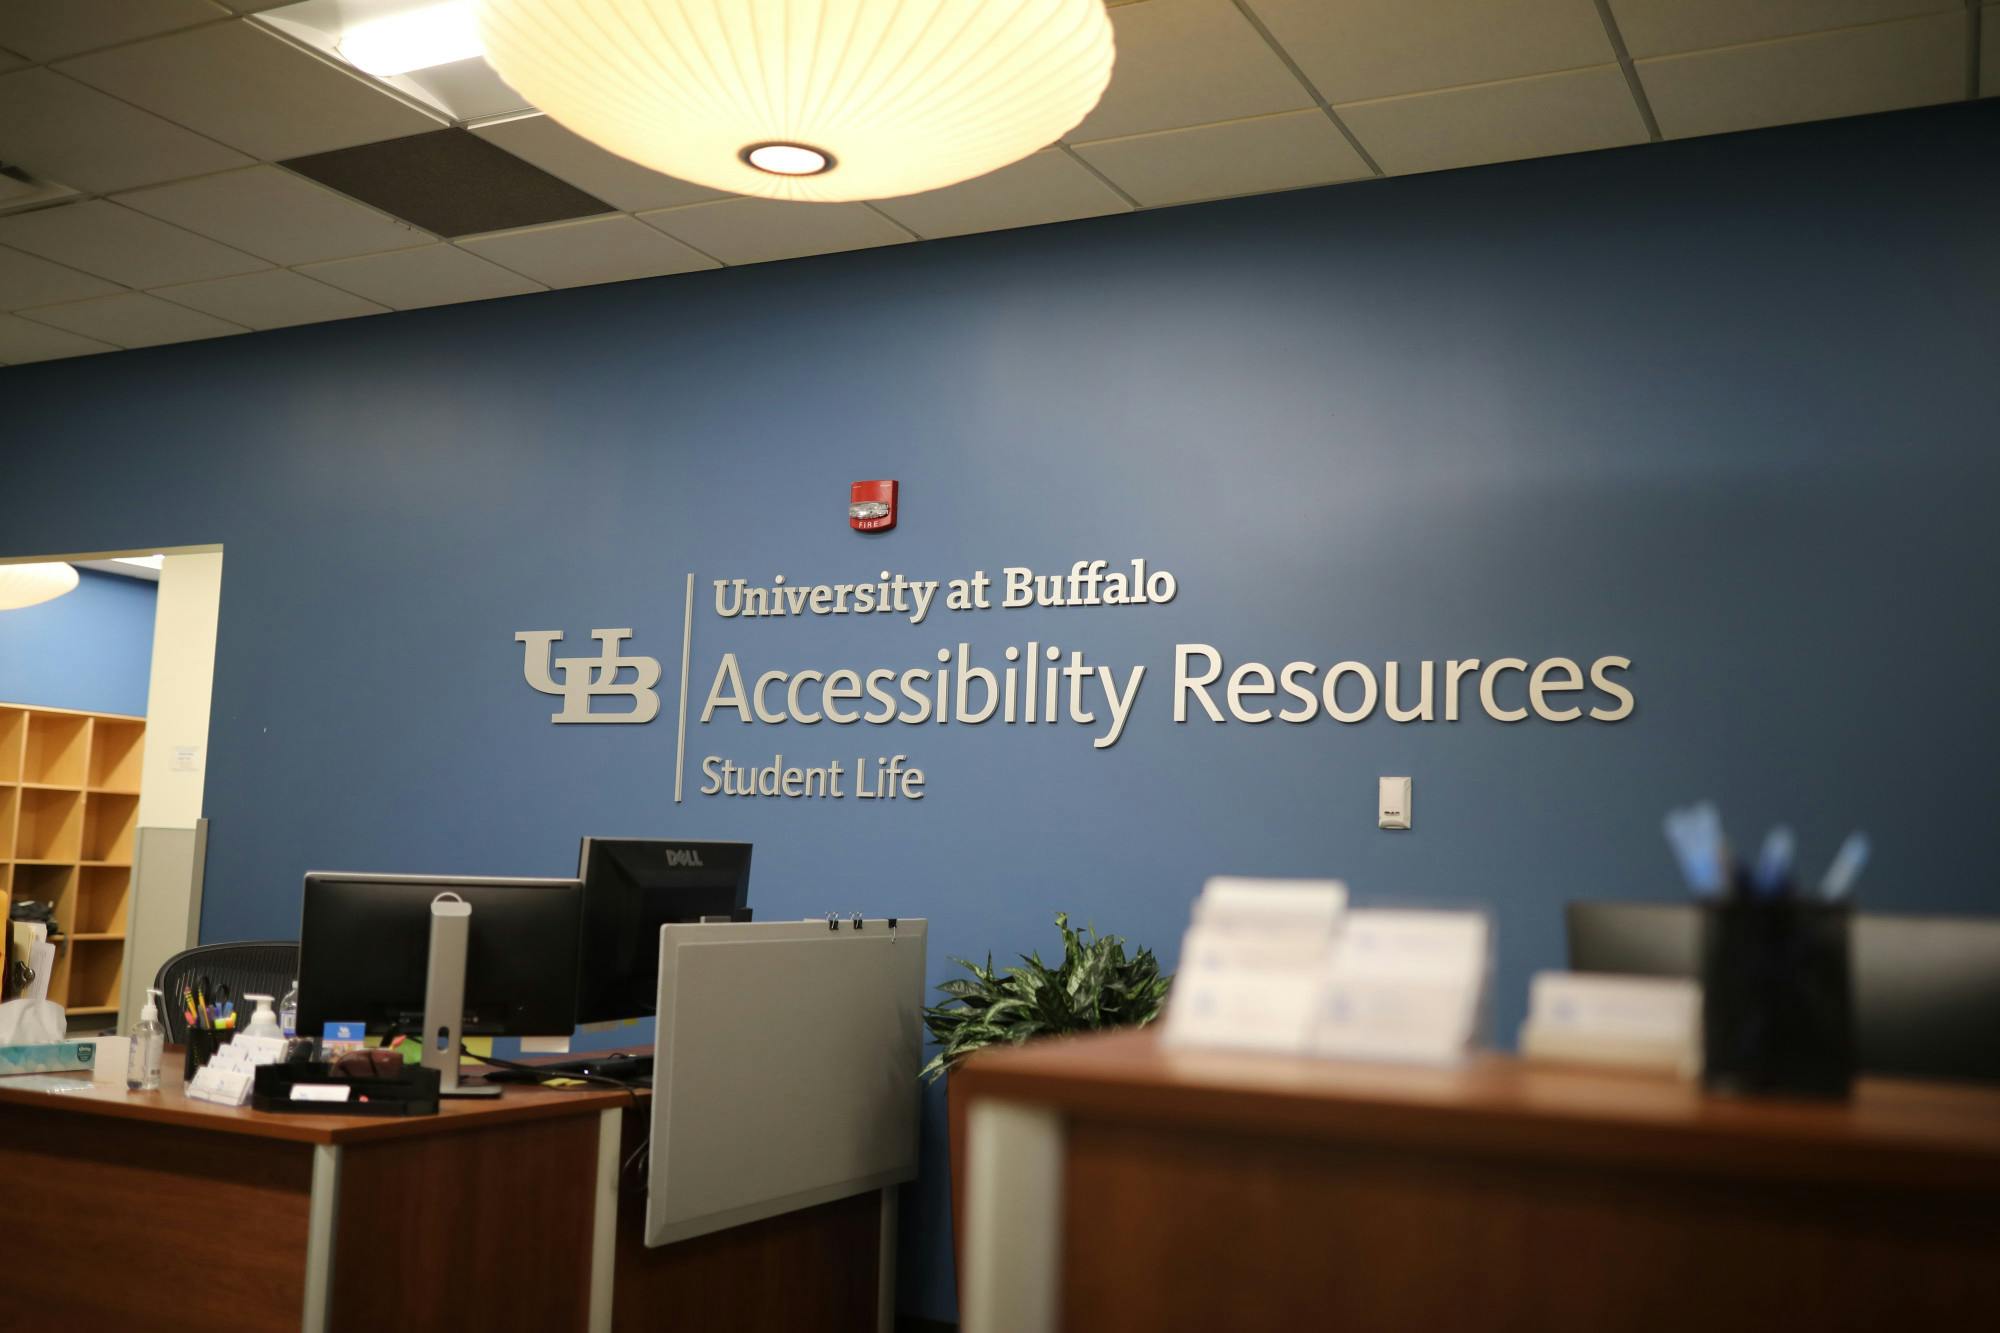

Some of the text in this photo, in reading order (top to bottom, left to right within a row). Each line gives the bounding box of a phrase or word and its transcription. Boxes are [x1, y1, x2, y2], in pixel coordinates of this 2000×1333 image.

[713, 558, 1177, 623] University at Buffalo
[514, 627, 661, 723] UB
[700, 641, 1636, 748] Accessibility Resources
[701, 754, 925, 799] Student Life
[665, 849, 704, 867] DELL
